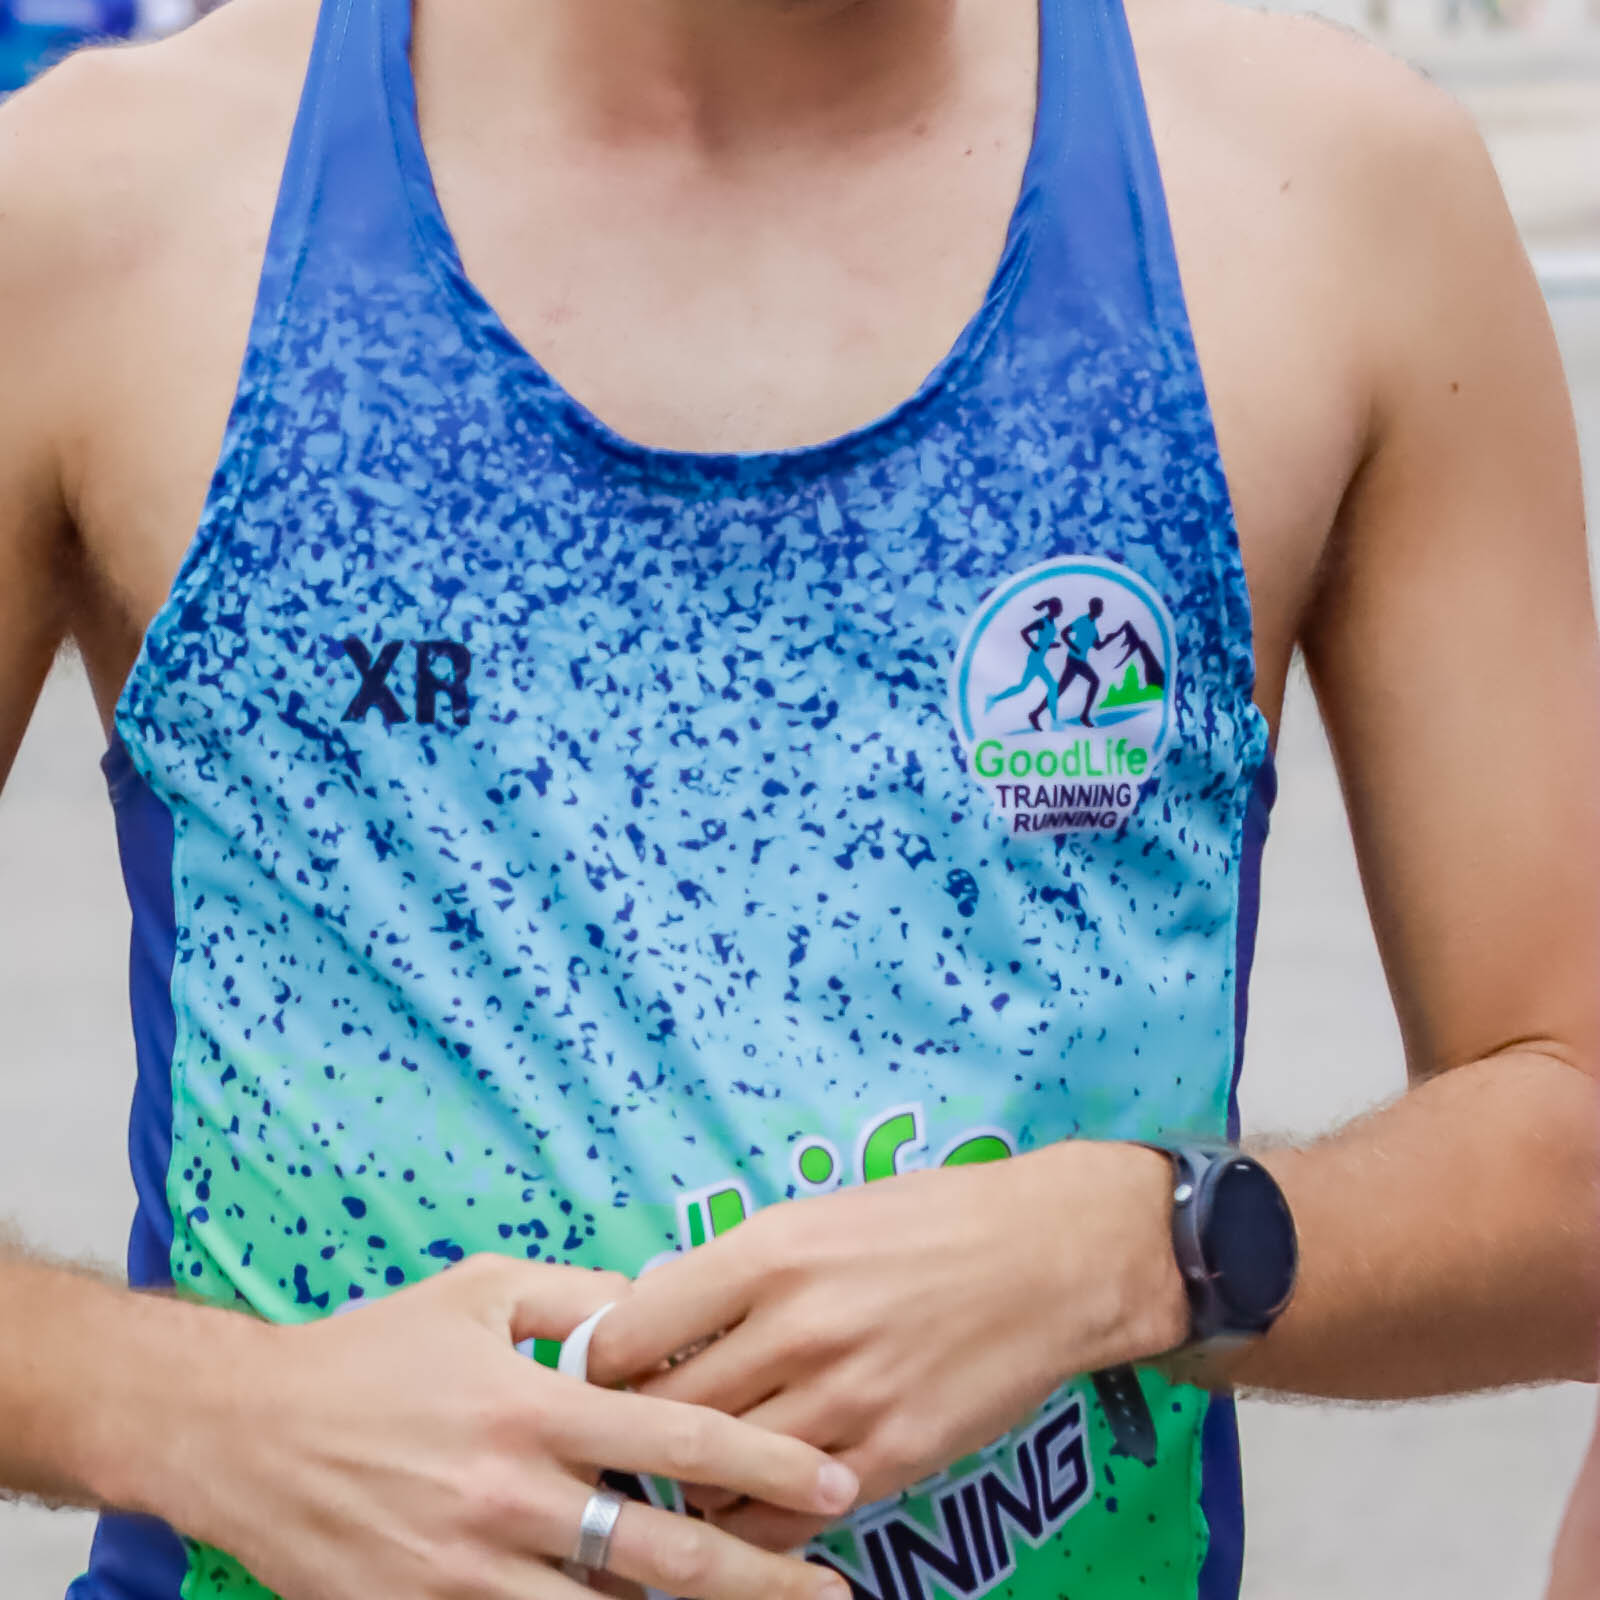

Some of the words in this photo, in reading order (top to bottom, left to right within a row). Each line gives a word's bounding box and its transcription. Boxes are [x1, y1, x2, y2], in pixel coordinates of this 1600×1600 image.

[341, 636, 472, 726] XR
[974, 738, 1149, 779] GoodLife
[996, 782, 1132, 810] TRAINNING
[1013, 811, 1119, 833] RUNNING
